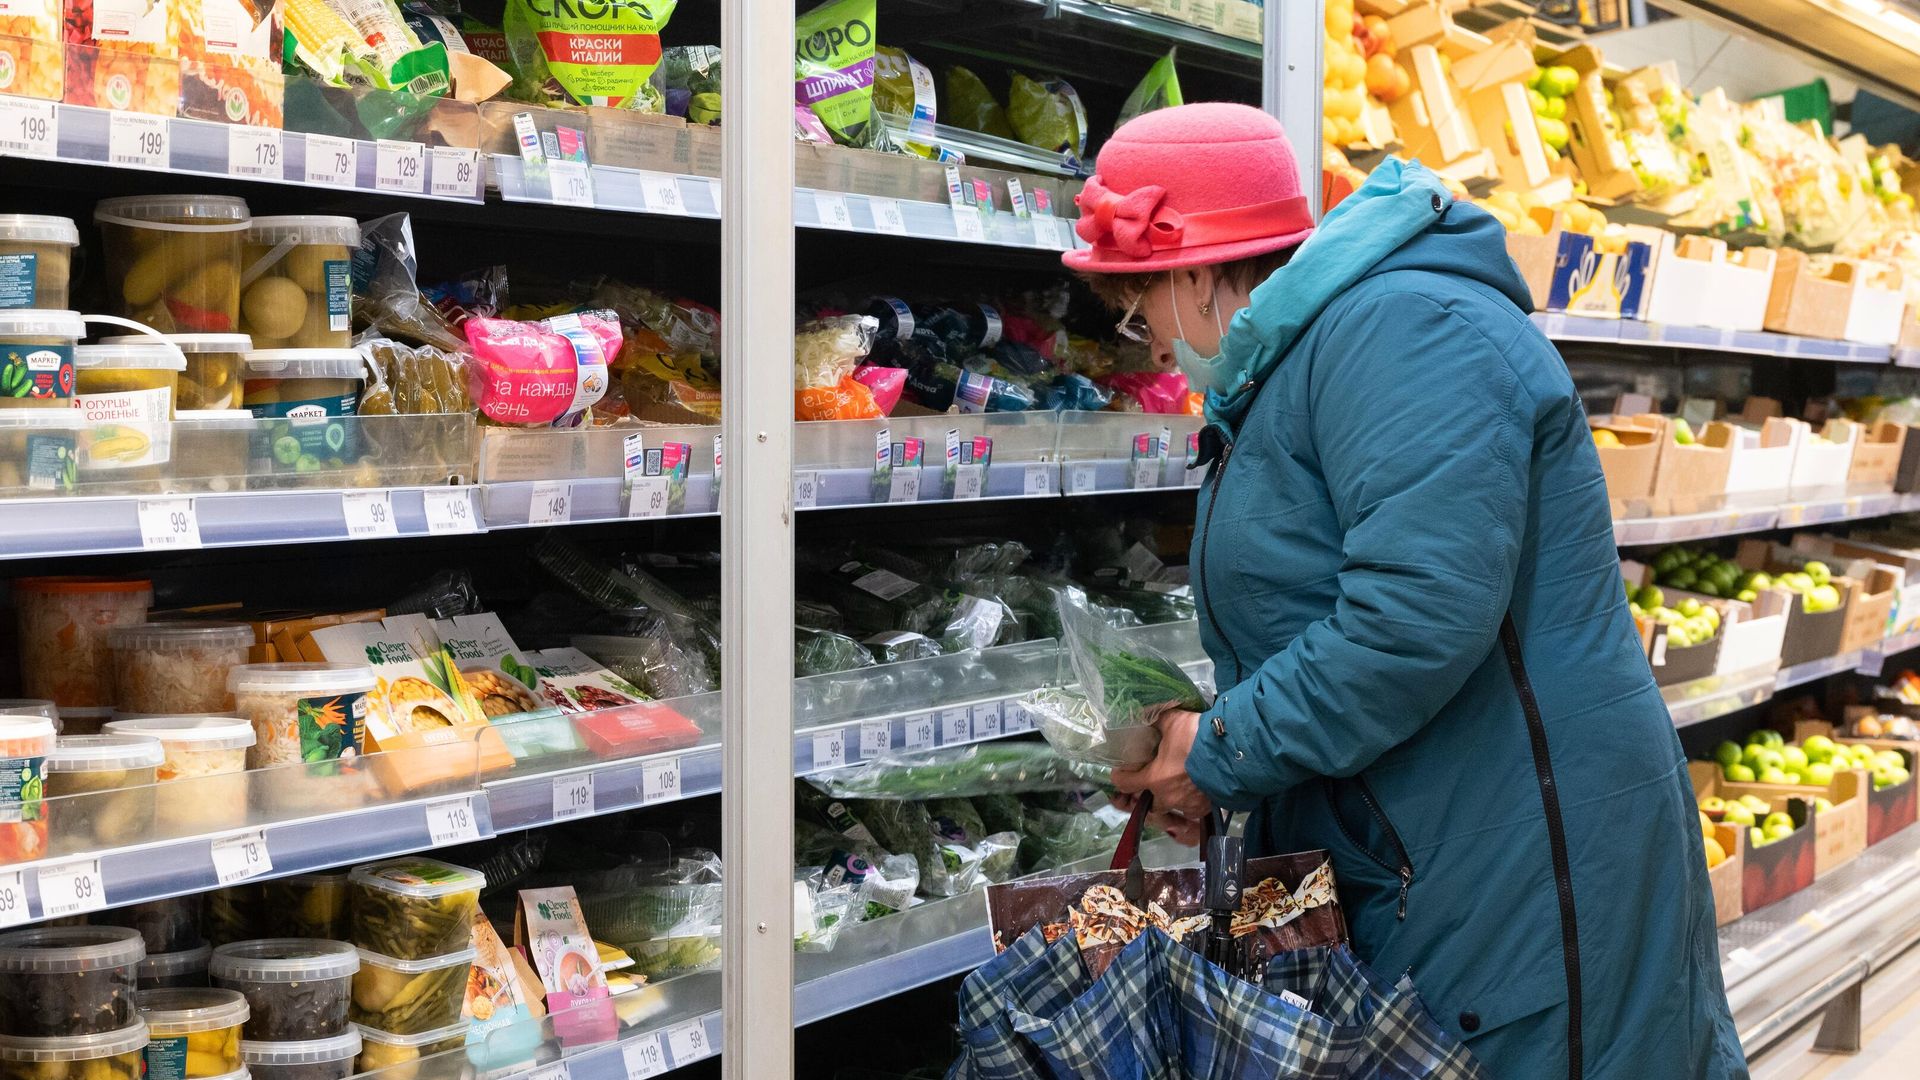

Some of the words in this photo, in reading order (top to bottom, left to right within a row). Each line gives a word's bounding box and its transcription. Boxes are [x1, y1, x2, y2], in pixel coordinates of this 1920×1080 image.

[580, 23, 624, 31] ПОМОЩНИК
[569, 38, 622, 50] КРАСКИ
[571, 51, 622, 63] ИТАЛИИ
[805, 68, 865, 99] ШПИНАТ
[20, 116, 46, 141] 199
[140, 131, 162, 155] 199
[255, 143, 276, 165] 179
[335, 152, 348, 174] 79
[397, 156, 416, 177] 129
[457, 162, 470, 182] 89
[568, 178, 585, 197] 179
[659, 187, 675, 206] 189
[86, 398, 132, 410] ОГУРЦЫ
[87, 409, 141, 421] СОЛЕНЫЕ
[290, 410, 324, 418] МАРКЕТ
[903, 480, 914, 496] 119
[966, 479, 978, 494] 139
[1035, 474, 1046, 489] 129
[799, 482, 812, 499] 189
[548, 497, 565, 516] 149
[650, 491, 662, 509] 69
[371, 503, 386, 523] 99
[446, 500, 466, 520] 149
[170, 512, 187, 533] 99
[376, 641, 407, 654] Clever
[448, 638, 478, 650] Clever
[386, 653, 413, 665] Foods
[457, 650, 485, 660] Foods
[954, 719, 965, 734] 159
[985, 713, 996, 729] 129
[876, 732, 886, 747] 99
[917, 725, 929, 741] 119
[830, 741, 840, 758] 99
[659, 771, 674, 789] 109
[570, 786, 587, 806] 119
[447, 808, 467, 829] 119
[242, 842, 259, 865] 79
[75, 875, 92, 899] 89
[546, 900, 569, 911] Clever
[552, 910, 572, 921] Foods
[690, 1030, 702, 1049] 59
[640, 1045, 658, 1065] 119
